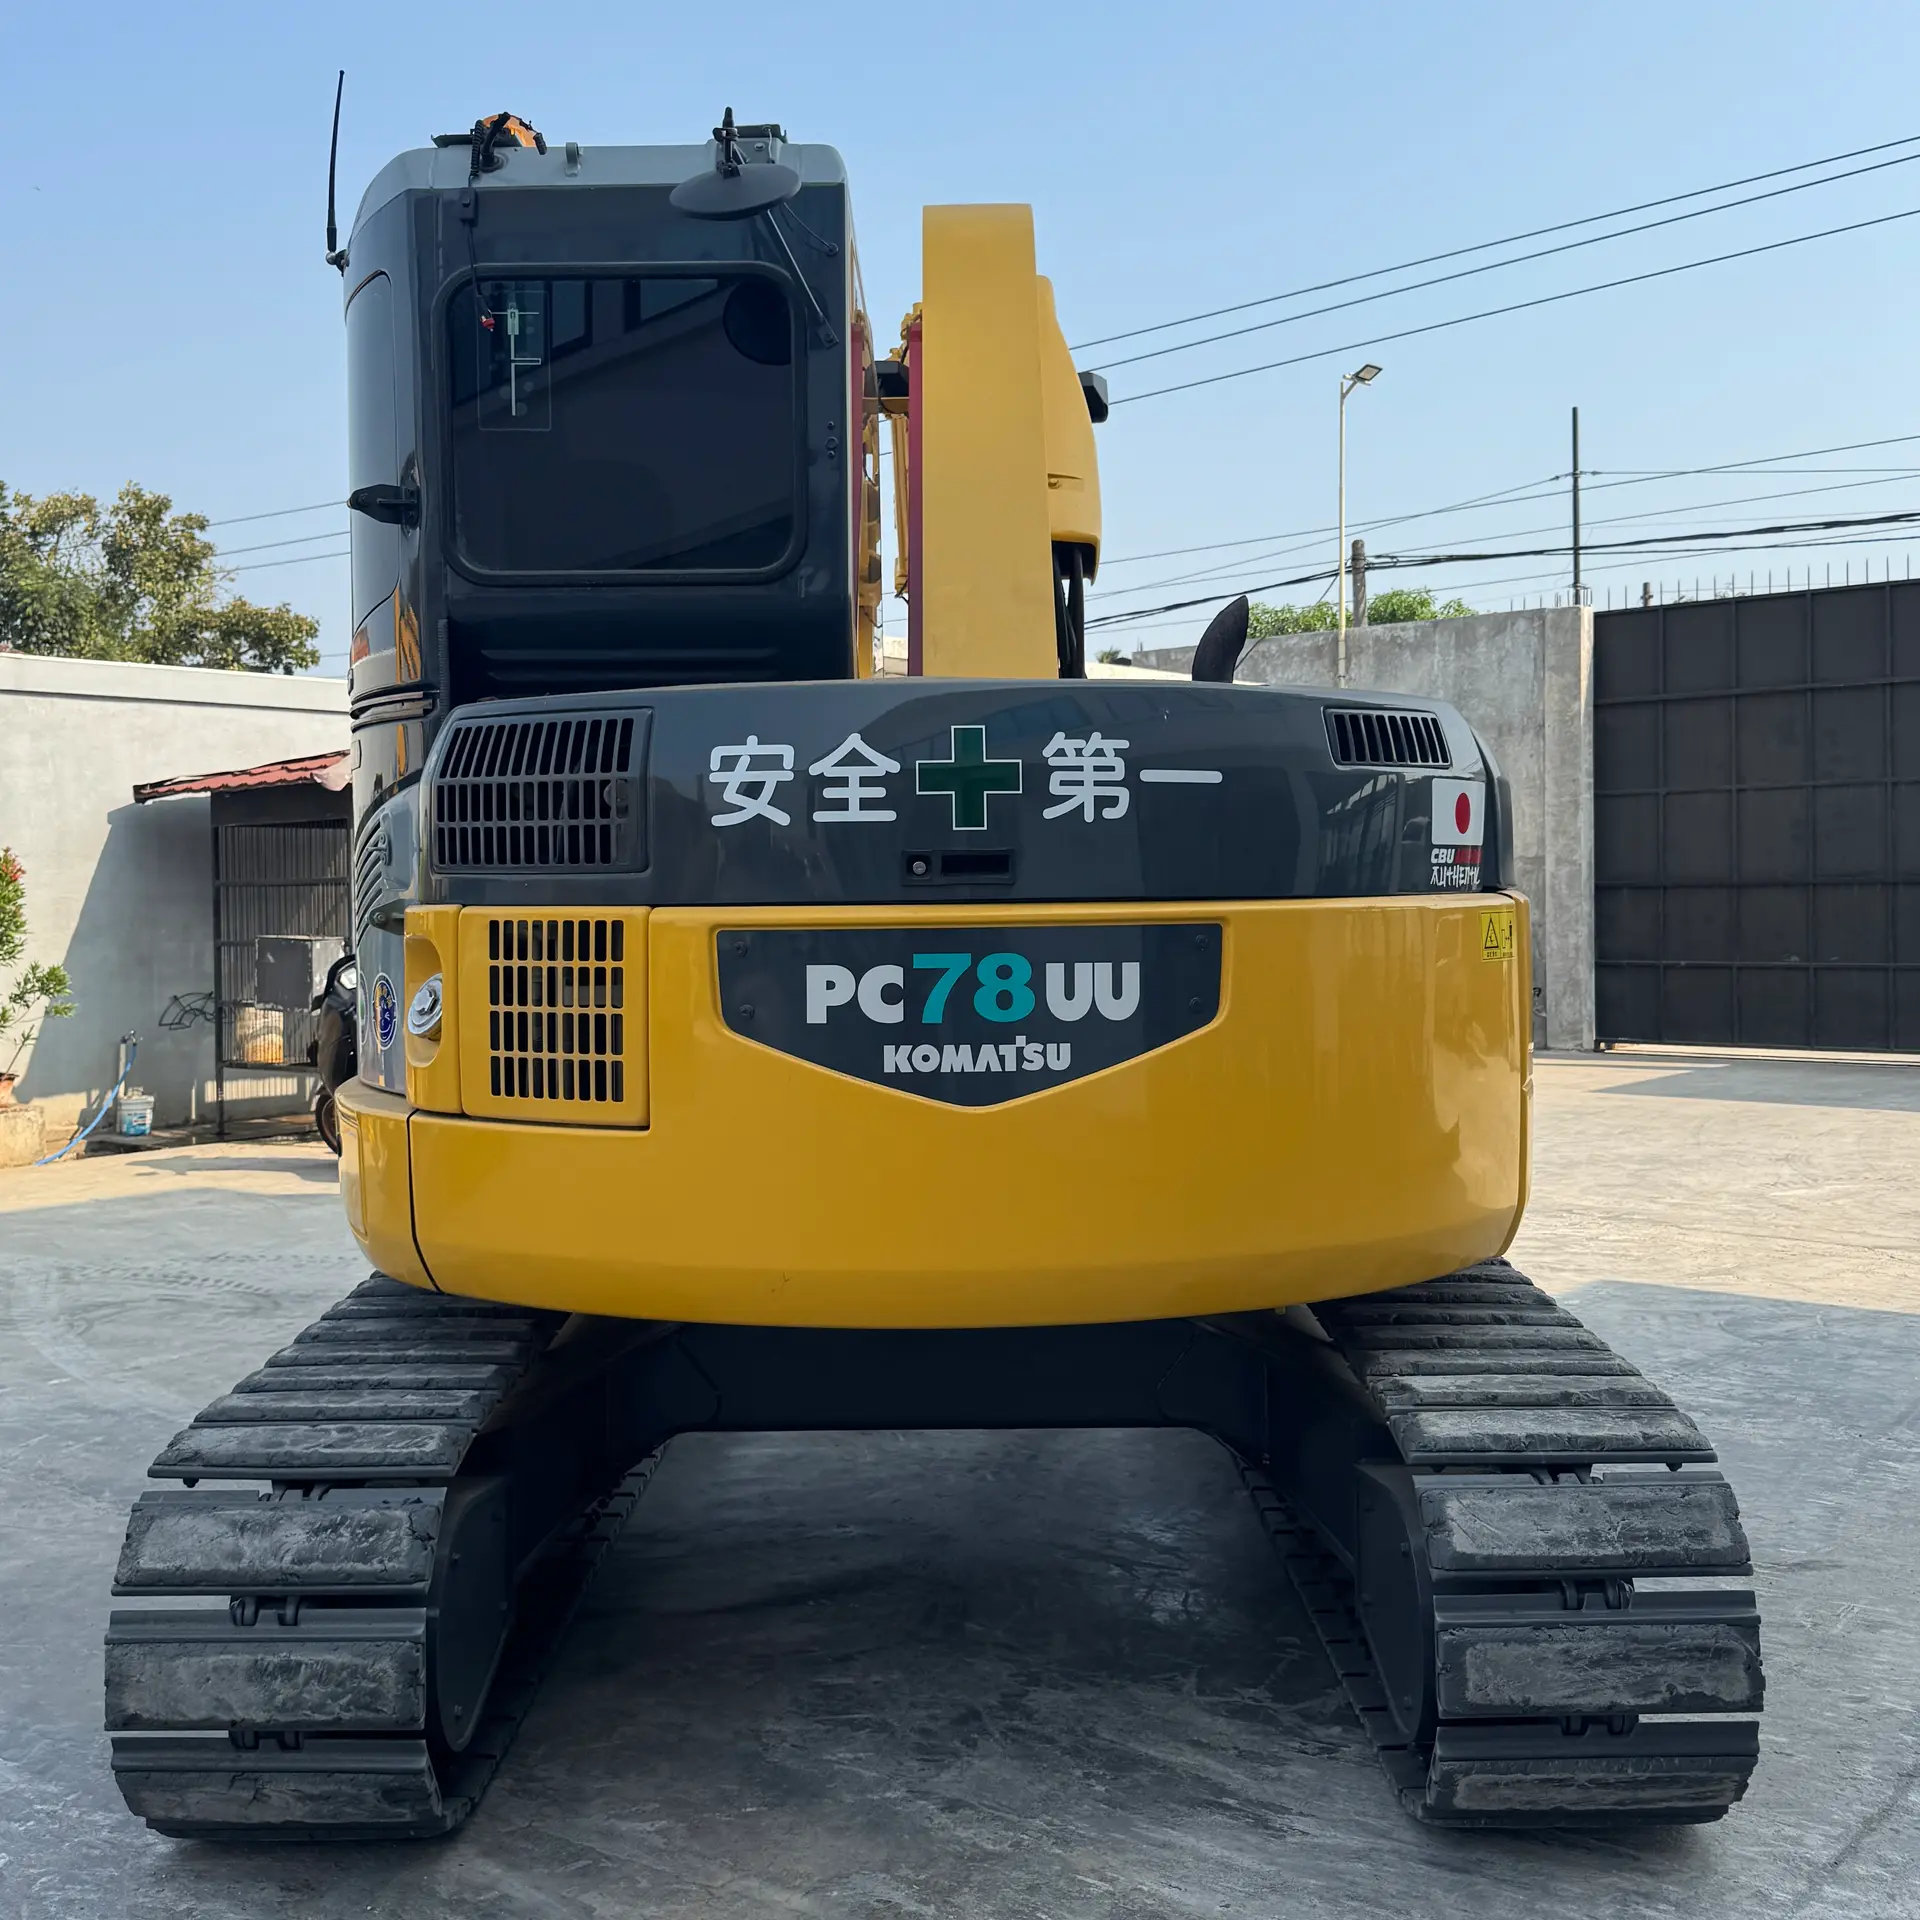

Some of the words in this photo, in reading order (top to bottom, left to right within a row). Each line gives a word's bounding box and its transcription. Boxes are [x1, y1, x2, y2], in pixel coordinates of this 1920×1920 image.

[709, 733, 901, 827] 安全
[1042, 731, 1223, 823] 第一
[1430, 848, 1456, 864] CBU
[806, 953, 1140, 1024] PC78UU
[883, 1035, 1071, 1073] KOMATSU
